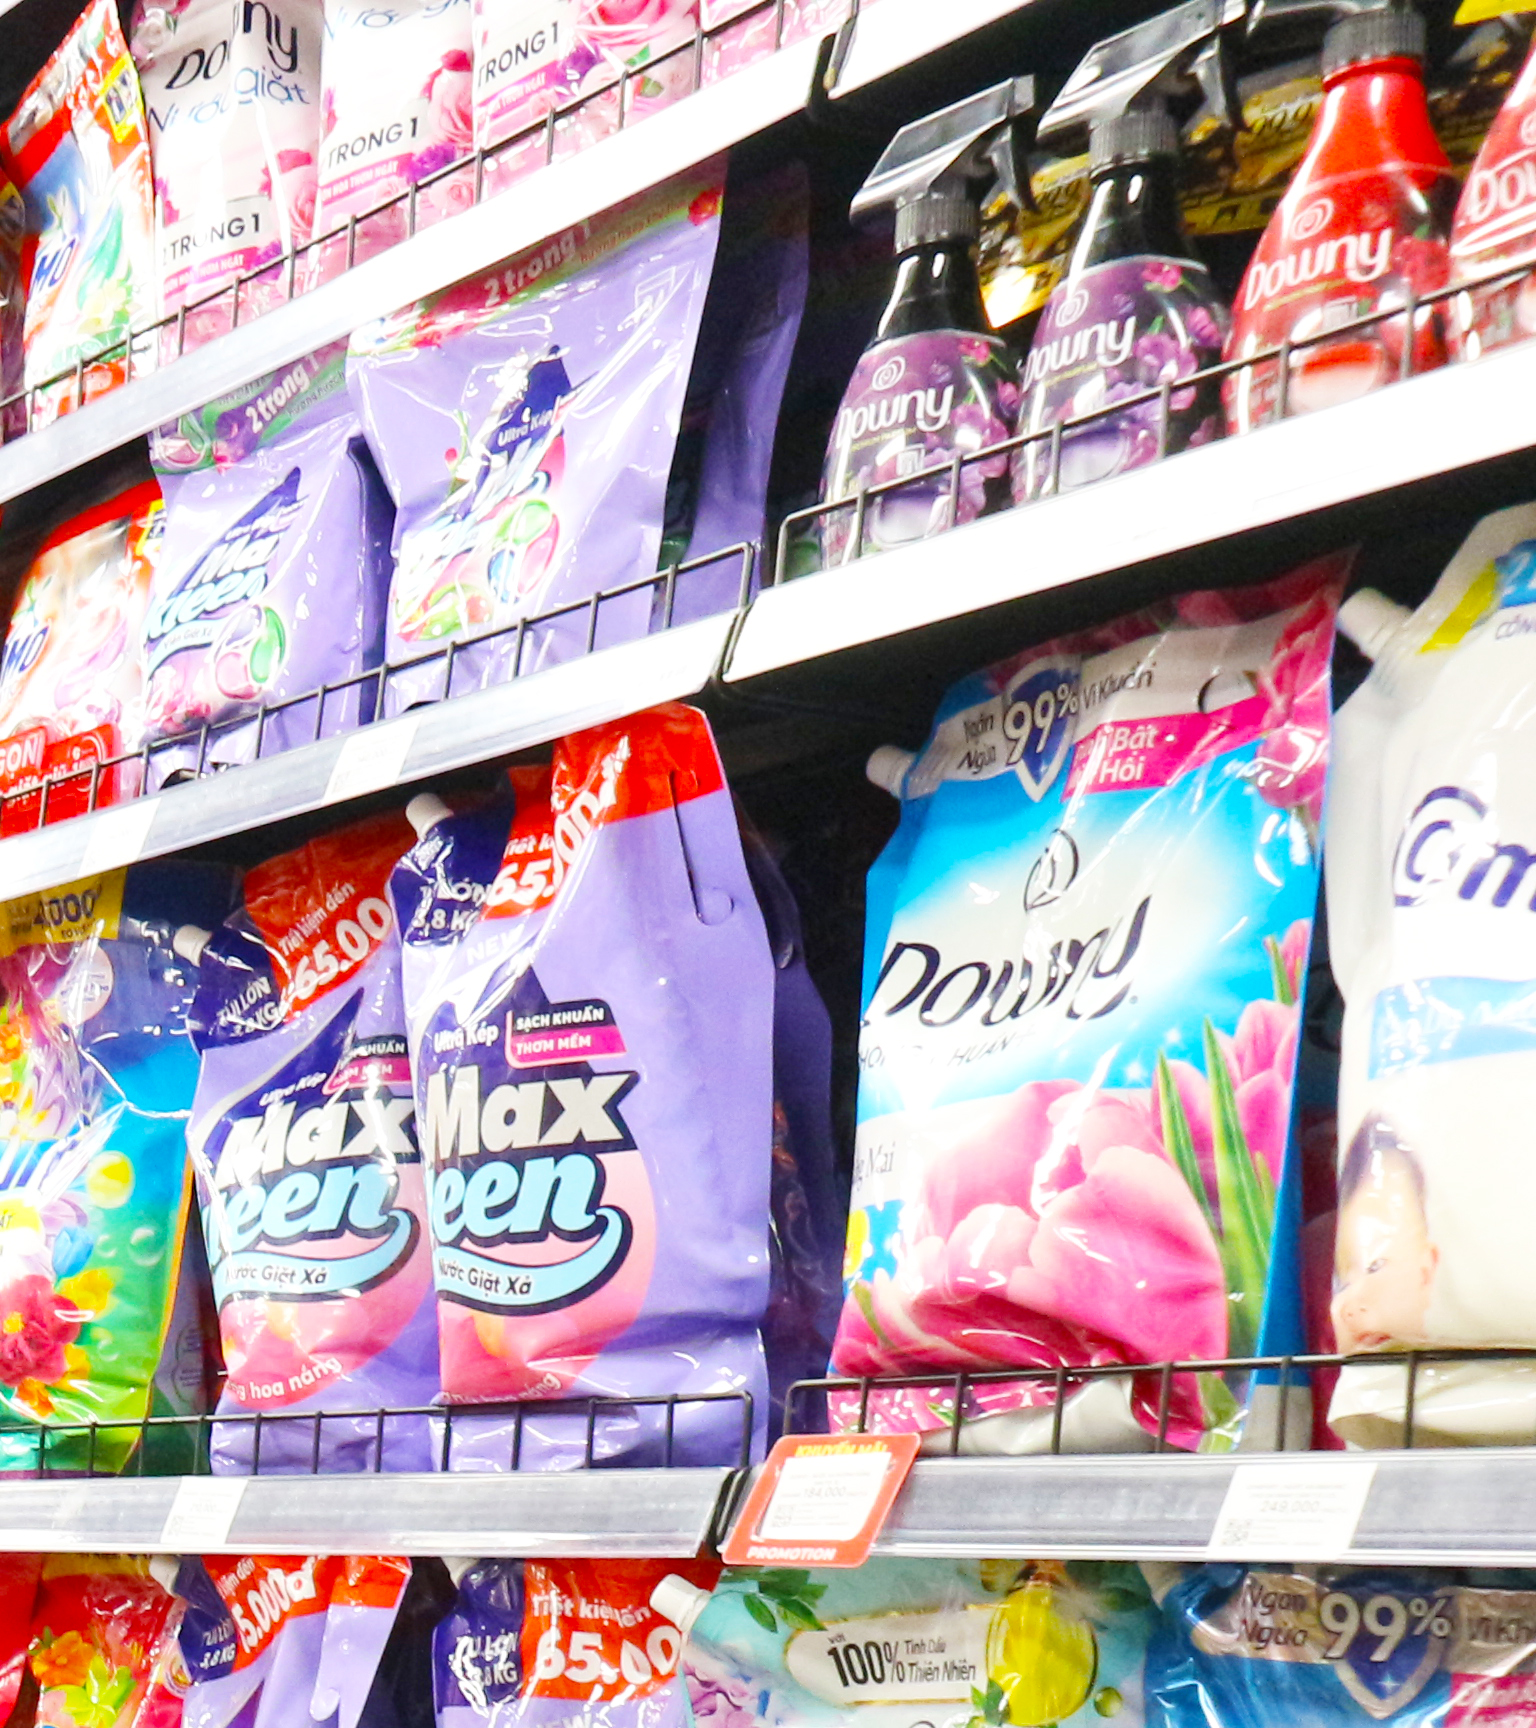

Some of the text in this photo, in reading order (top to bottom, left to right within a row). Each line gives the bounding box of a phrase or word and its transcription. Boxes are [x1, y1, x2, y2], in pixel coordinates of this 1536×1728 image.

[409, 117, 419, 138] 1
[504, 231, 577, 299] trong
[1243, 226, 1396, 311] Downy
[1021, 315, 1138, 398] Downy
[835, 382, 955, 450] Downy
[1003, 688, 1079, 766] 99%
[1111, 723, 1157, 753] Bật
[1099, 758, 1144, 784] Hôi
[861, 892, 1152, 1034] Downy
[466, 1019, 500, 1049] Kép
[515, 1004, 606, 1032] SẠCH KHUẨN
[515, 1032, 592, 1056] THƠM MỀM
[430, 1063, 632, 1161] Max
[217, 1097, 418, 1190] Max
[432, 1153, 597, 1243] een
[467, 1267, 502, 1298] Giặt
[504, 1272, 533, 1295] Xả
[248, 1355, 342, 1401] hoa nắng
[747, 1546, 836, 1562] PROMOTION
[1321, 1592, 1453, 1663] 99%
[827, 1638, 906, 1688] 100%
[906, 1657, 977, 1683] Thiên Nhiên
